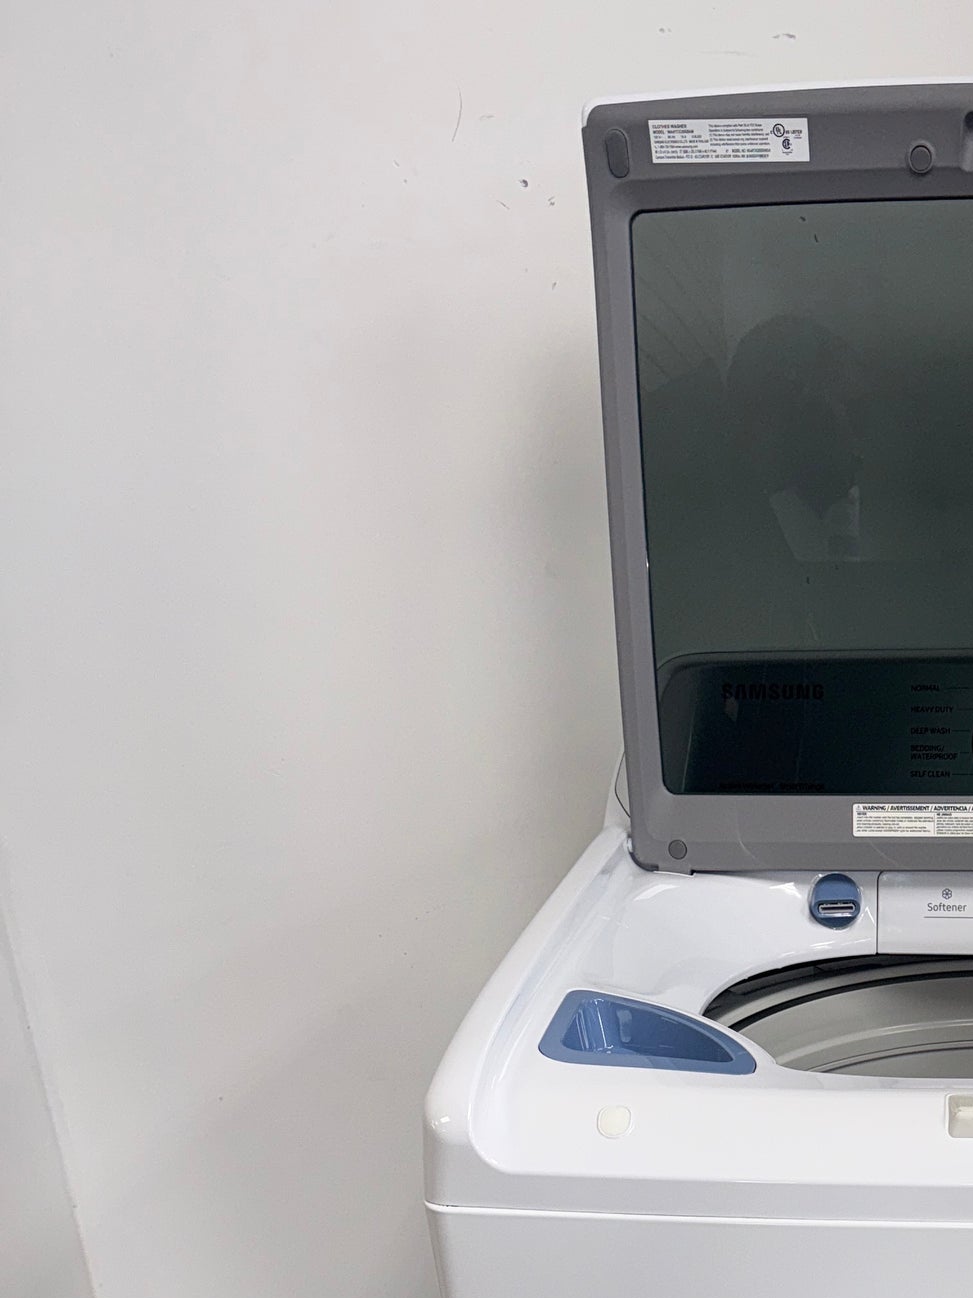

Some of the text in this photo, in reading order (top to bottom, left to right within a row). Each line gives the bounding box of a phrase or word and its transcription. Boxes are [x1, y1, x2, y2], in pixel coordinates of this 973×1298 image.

[721, 683, 825, 700] SAMSUNG
[910, 770, 950, 778] SELF CLEAN
[927, 902, 967, 912] Softener
